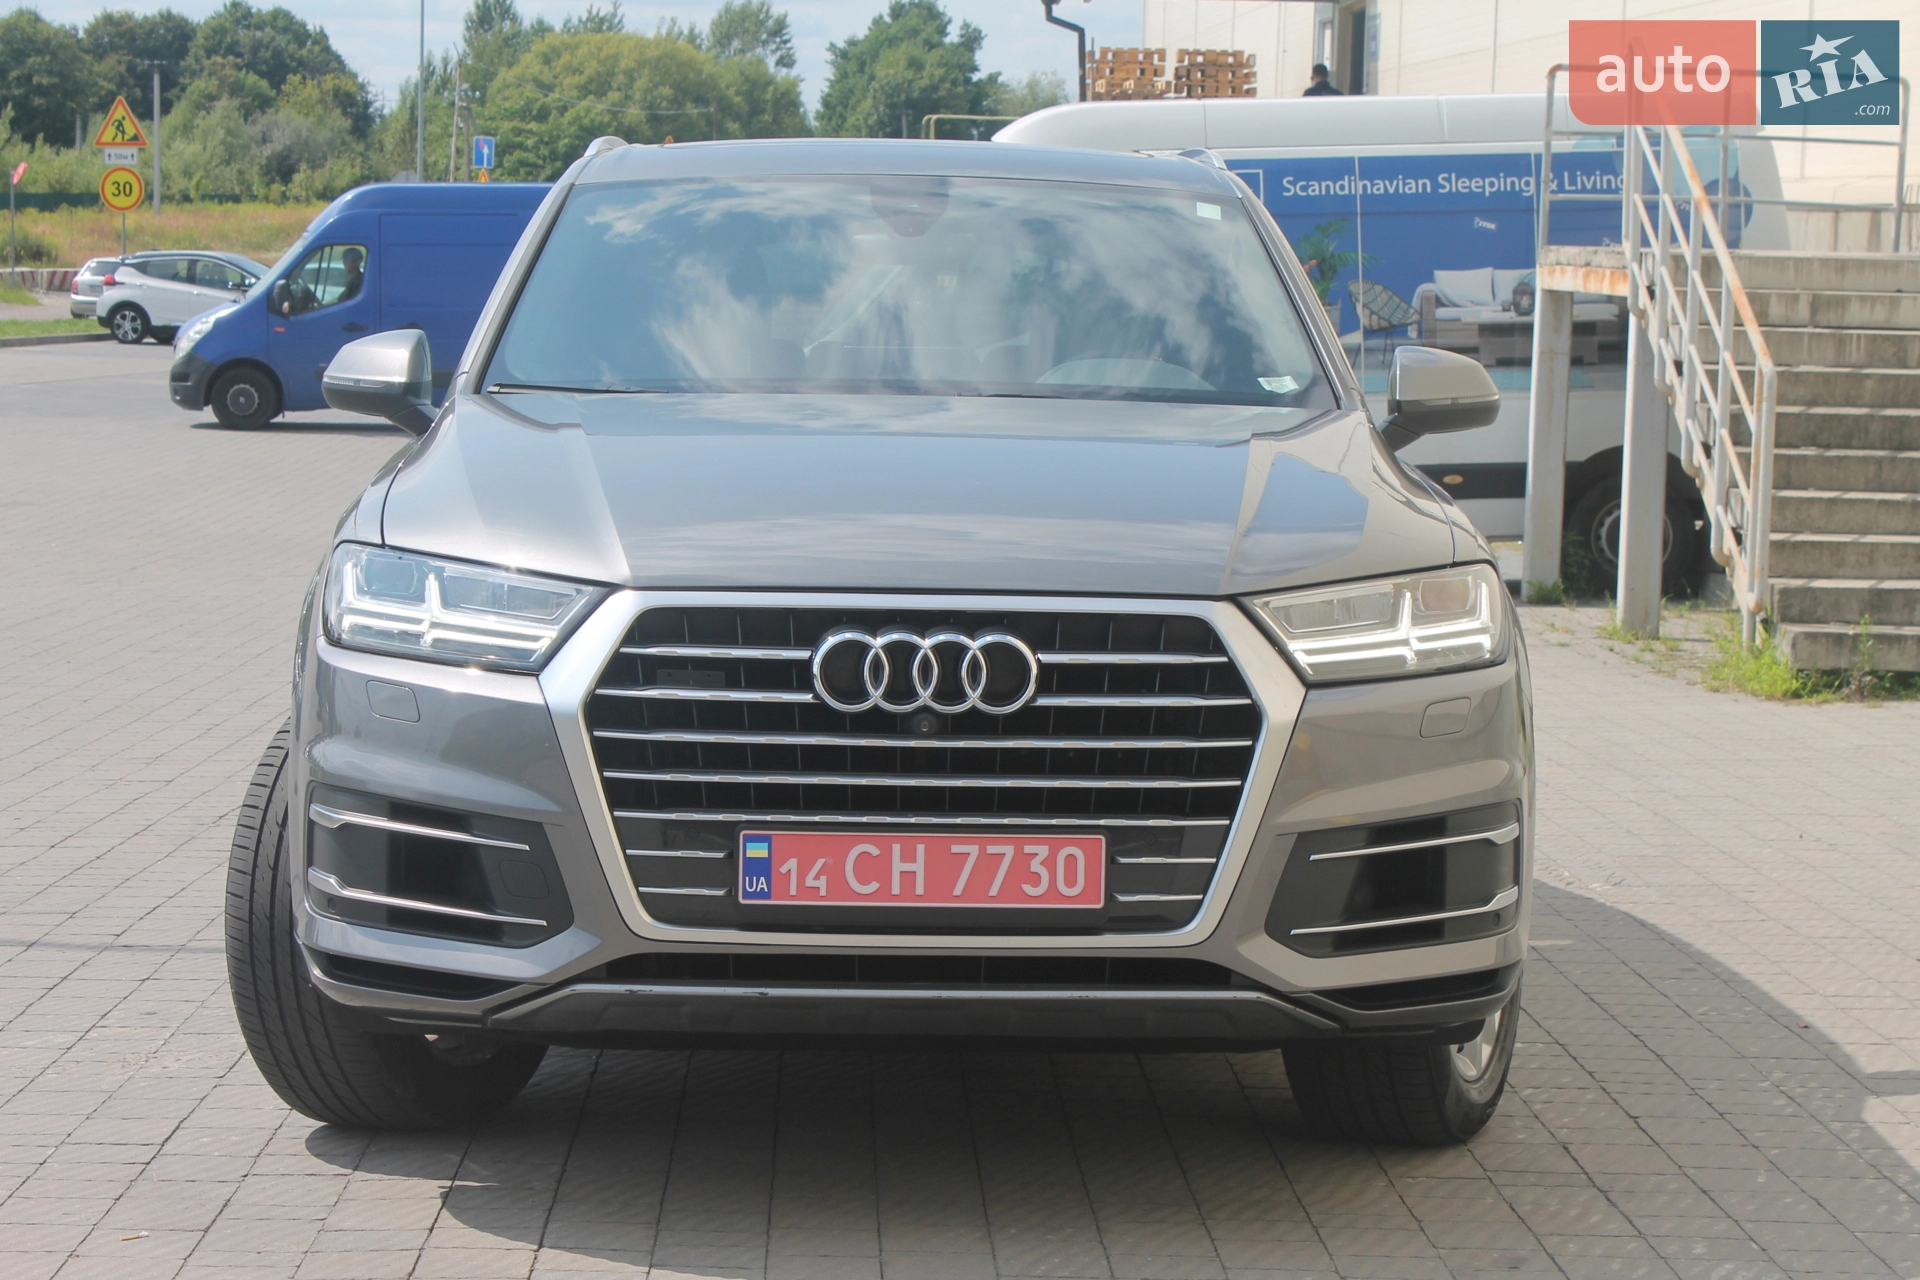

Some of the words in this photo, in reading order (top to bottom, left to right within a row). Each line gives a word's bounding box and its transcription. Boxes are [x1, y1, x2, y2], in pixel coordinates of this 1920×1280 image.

[111, 181, 133, 197] 30
[1282, 175, 1431, 196] Scandinavian
[1437, 172, 1534, 197] Sleeping
[779, 858, 828, 897] 14
[844, 843, 925, 895] CH
[950, 845, 1085, 897] 7730
[745, 876, 768, 892] UA
